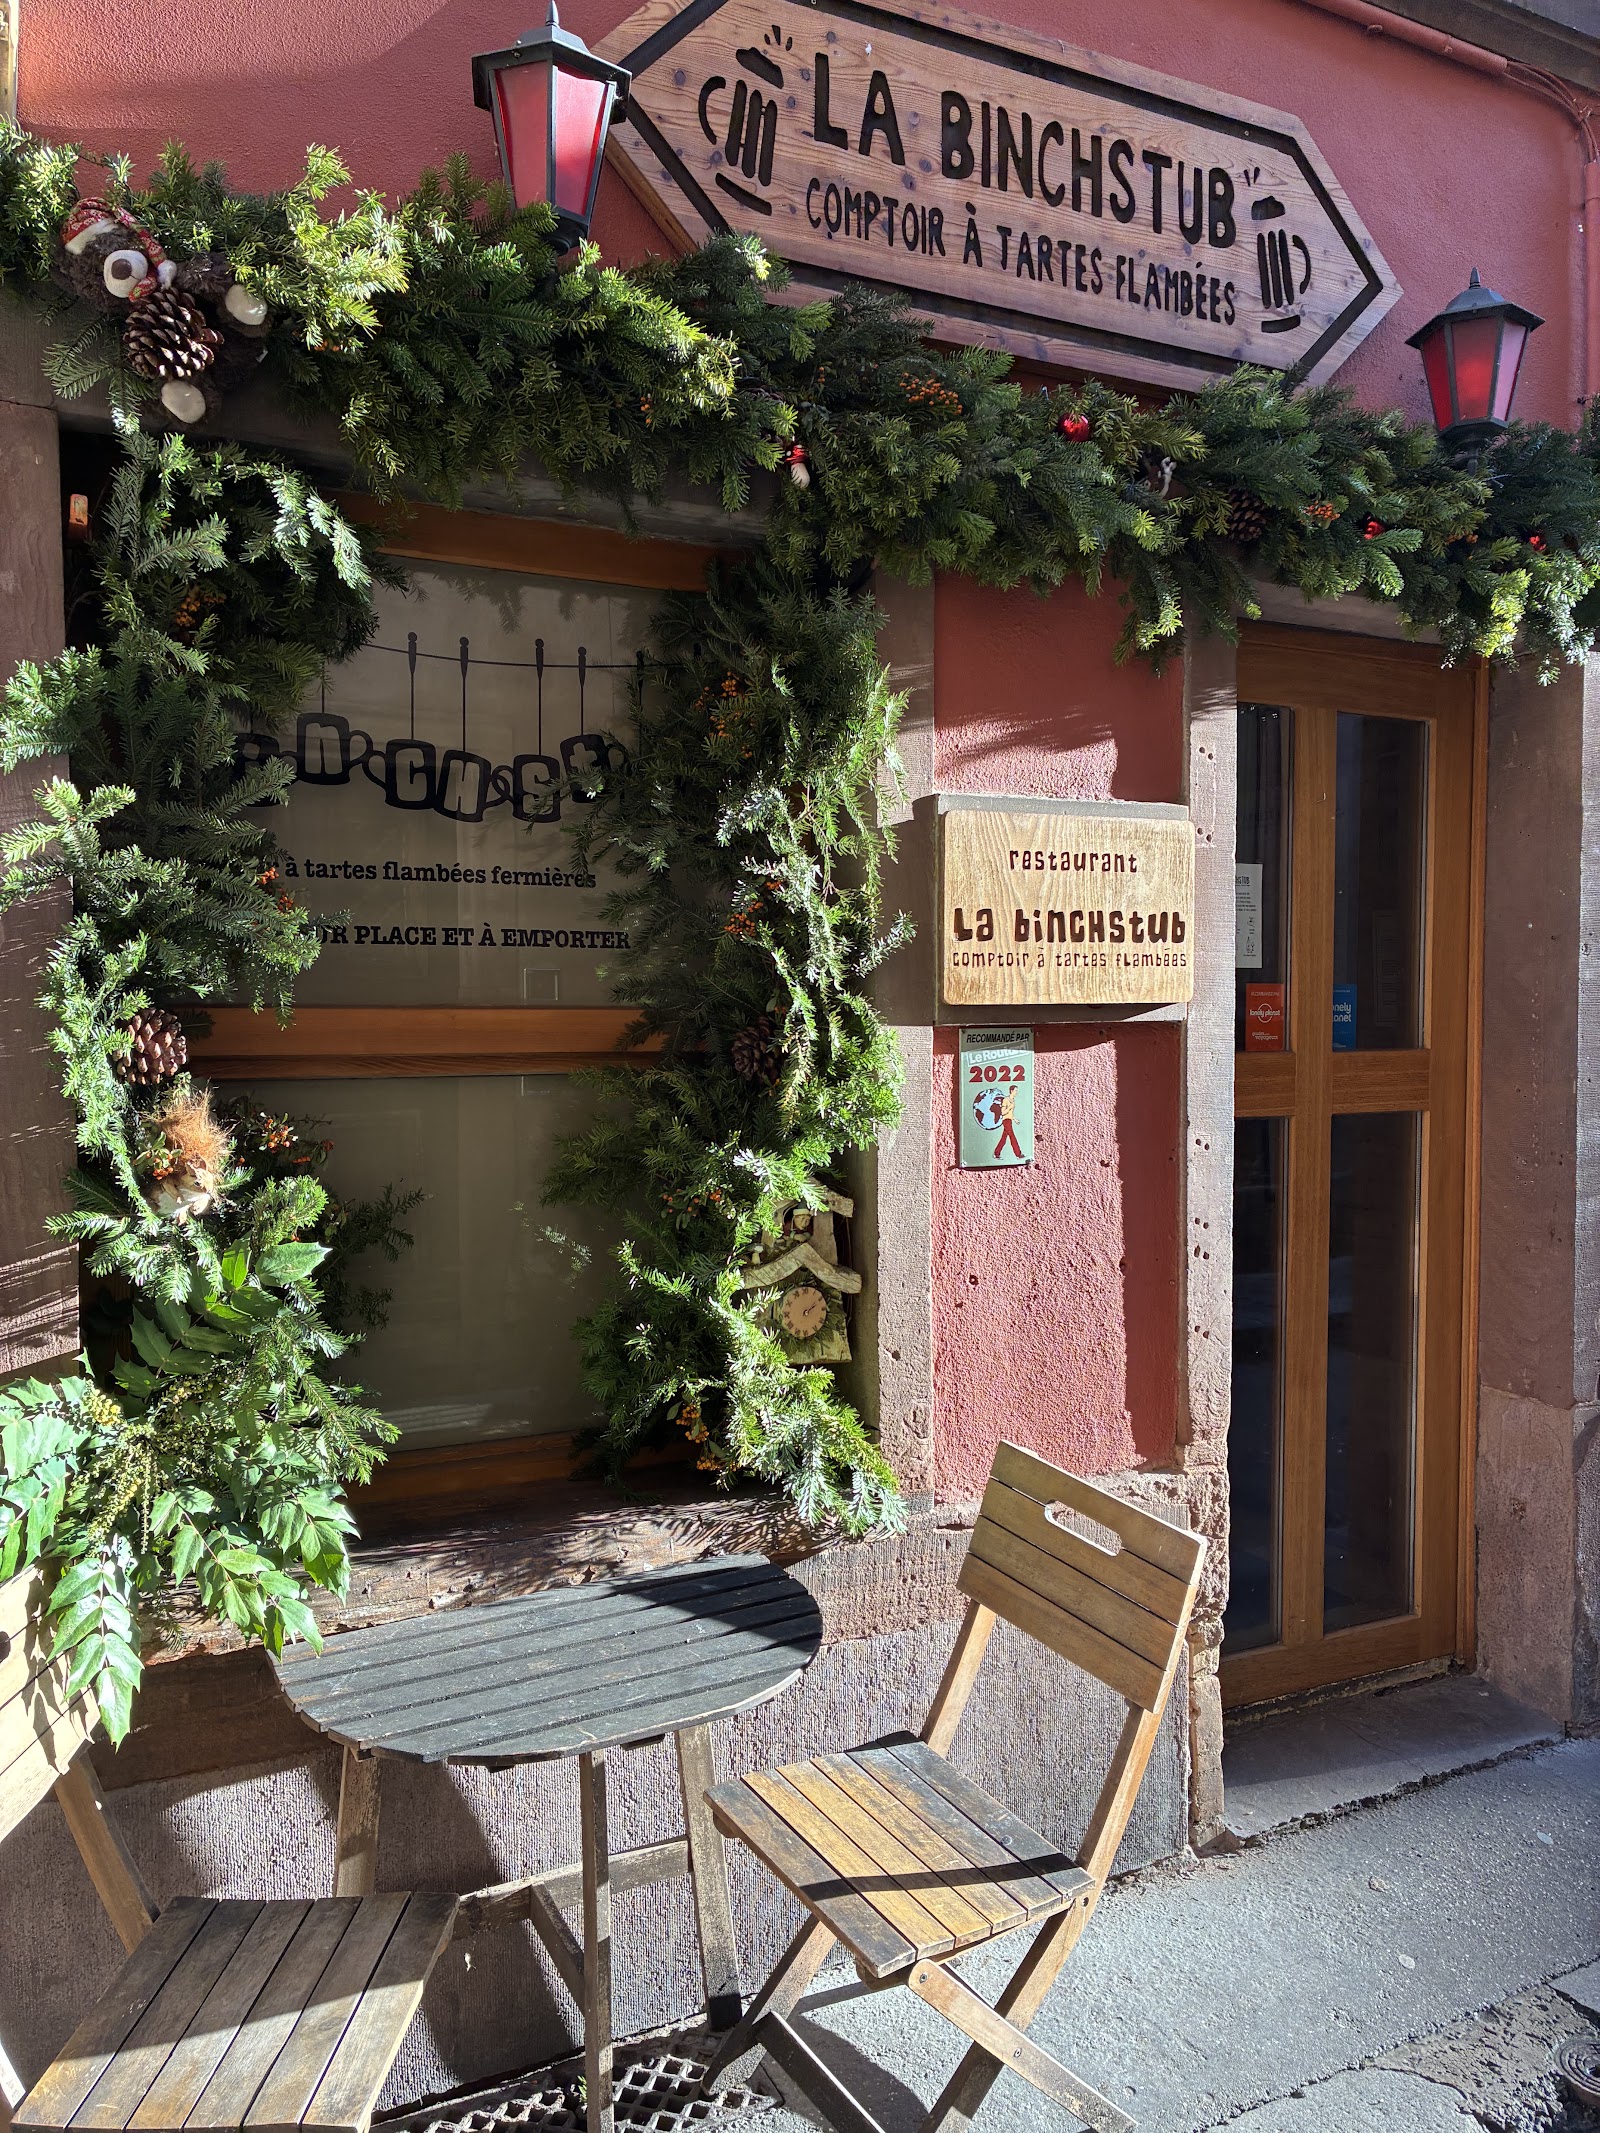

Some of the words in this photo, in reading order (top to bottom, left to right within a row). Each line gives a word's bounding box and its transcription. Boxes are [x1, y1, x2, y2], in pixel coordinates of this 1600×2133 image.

[813, 51, 906, 167] LA
[940, 90, 1238, 250] BINCHSTUB
[805, 177, 946, 258] COMPTOIR
[962, 201, 984, 269] À
[996, 223, 1104, 297] TARTES
[1115, 254, 1237, 327] FLAMBÉES
[285, 856, 299, 878] à
[304, 859, 377, 880] tartes
[383, 861, 487, 884] flambées
[491, 866, 597, 888] fermières
[1009, 850, 1138, 873] restaurant
[354, 925, 436, 945] PLACE
[442, 927, 474, 946] ET
[478, 922, 497, 946] À
[501, 928, 631, 949] EMPORTER
[953, 907, 994, 942] La
[952, 952, 1029, 967] comptoir
[1037, 946, 1045, 968] à
[1056, 953, 1107, 967] tartes
[967, 1031, 1015, 1044] RECOMMANDÉ
[1015, 1032, 1030, 1043] PAR
[969, 1065, 1026, 1083] 2022
